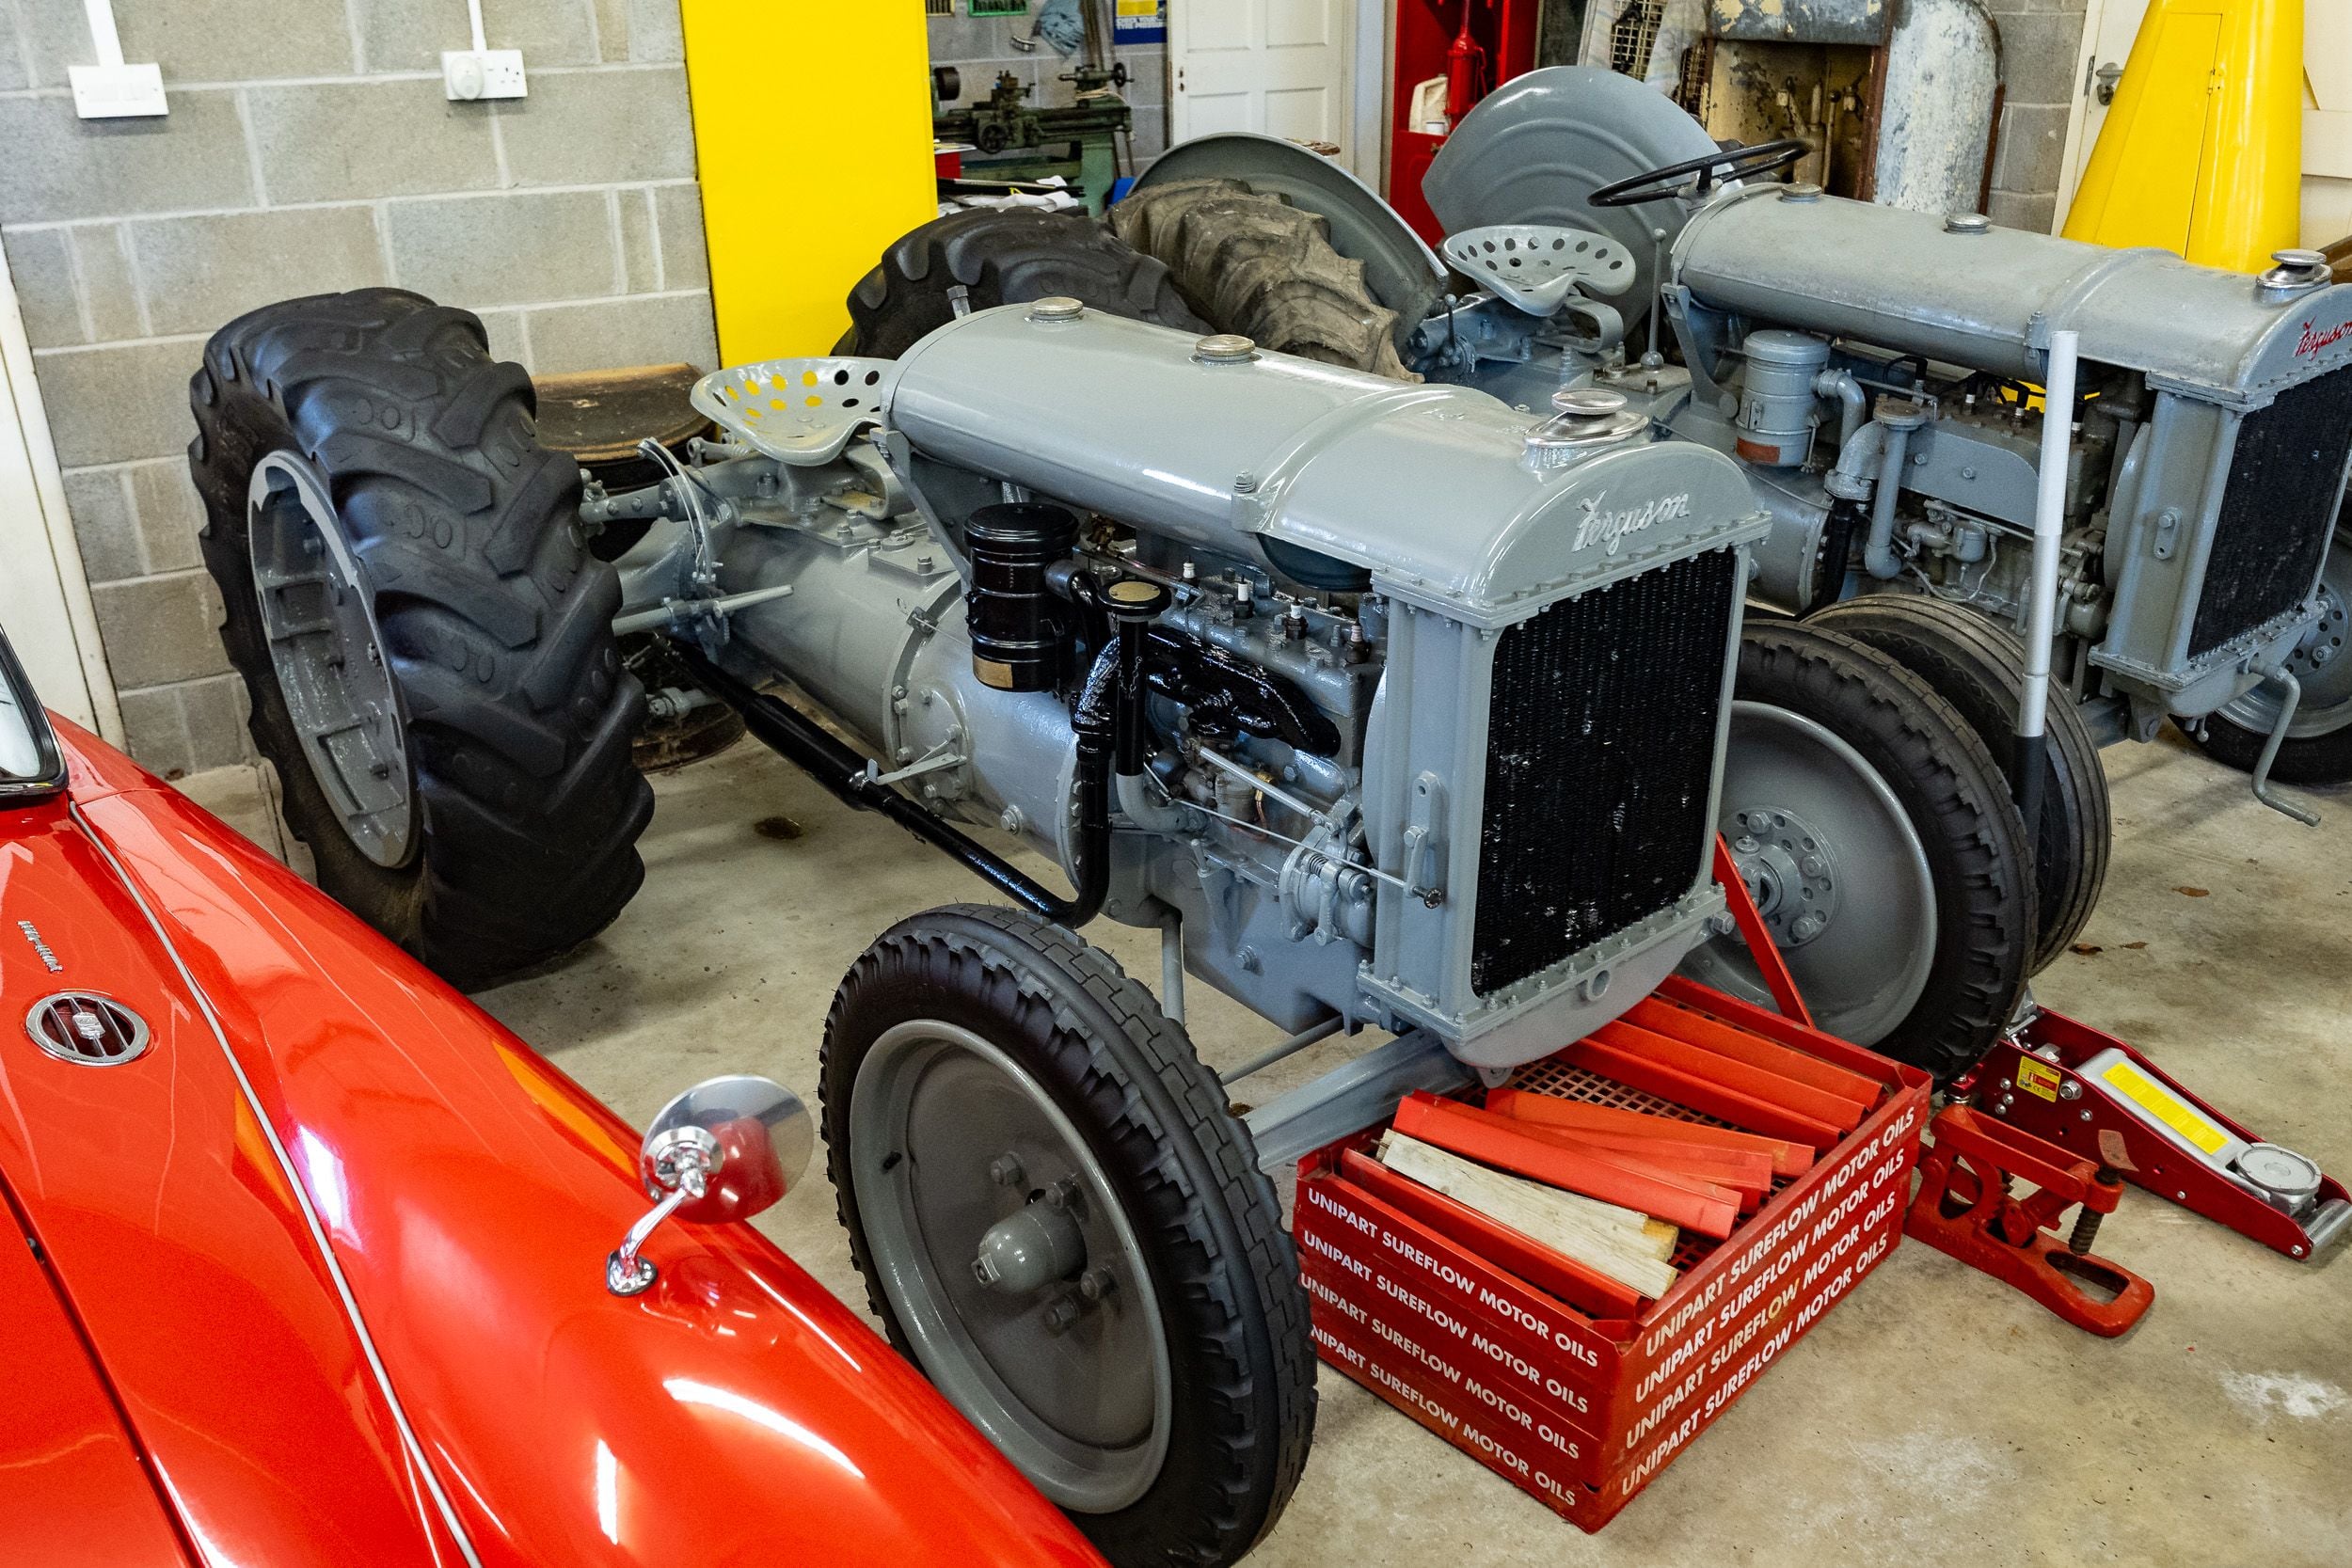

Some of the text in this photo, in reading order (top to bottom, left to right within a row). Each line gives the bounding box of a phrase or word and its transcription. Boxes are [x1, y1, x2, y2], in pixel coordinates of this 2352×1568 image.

[1570, 489, 1690, 556] Ferguson
[1304, 1229, 1588, 1414] UNIPART SUREFLOW MOTOR OILS
[1308, 1187, 1598, 1368] UNIPART SUREFLOW MOTOR OILS
[1626, 1191, 1896, 1449] UNIPART SUREFLOW MOTOR OILS
[1635, 1148, 1905, 1403] UNIPART SUREFLOW MOTOR OILS
[1645, 1106, 1915, 1357] UNIPART SUREFLOW MOTOR OILS
[1300, 1273, 1580, 1459] UNIPART SUREFLOW MOTOR OILS
[1311, 1324, 1576, 1506] NIPART SUREFLOW MOTOR OILS
[1622, 1232, 1888, 1496] UNIPART SUREFLOW MOTOR OILS
